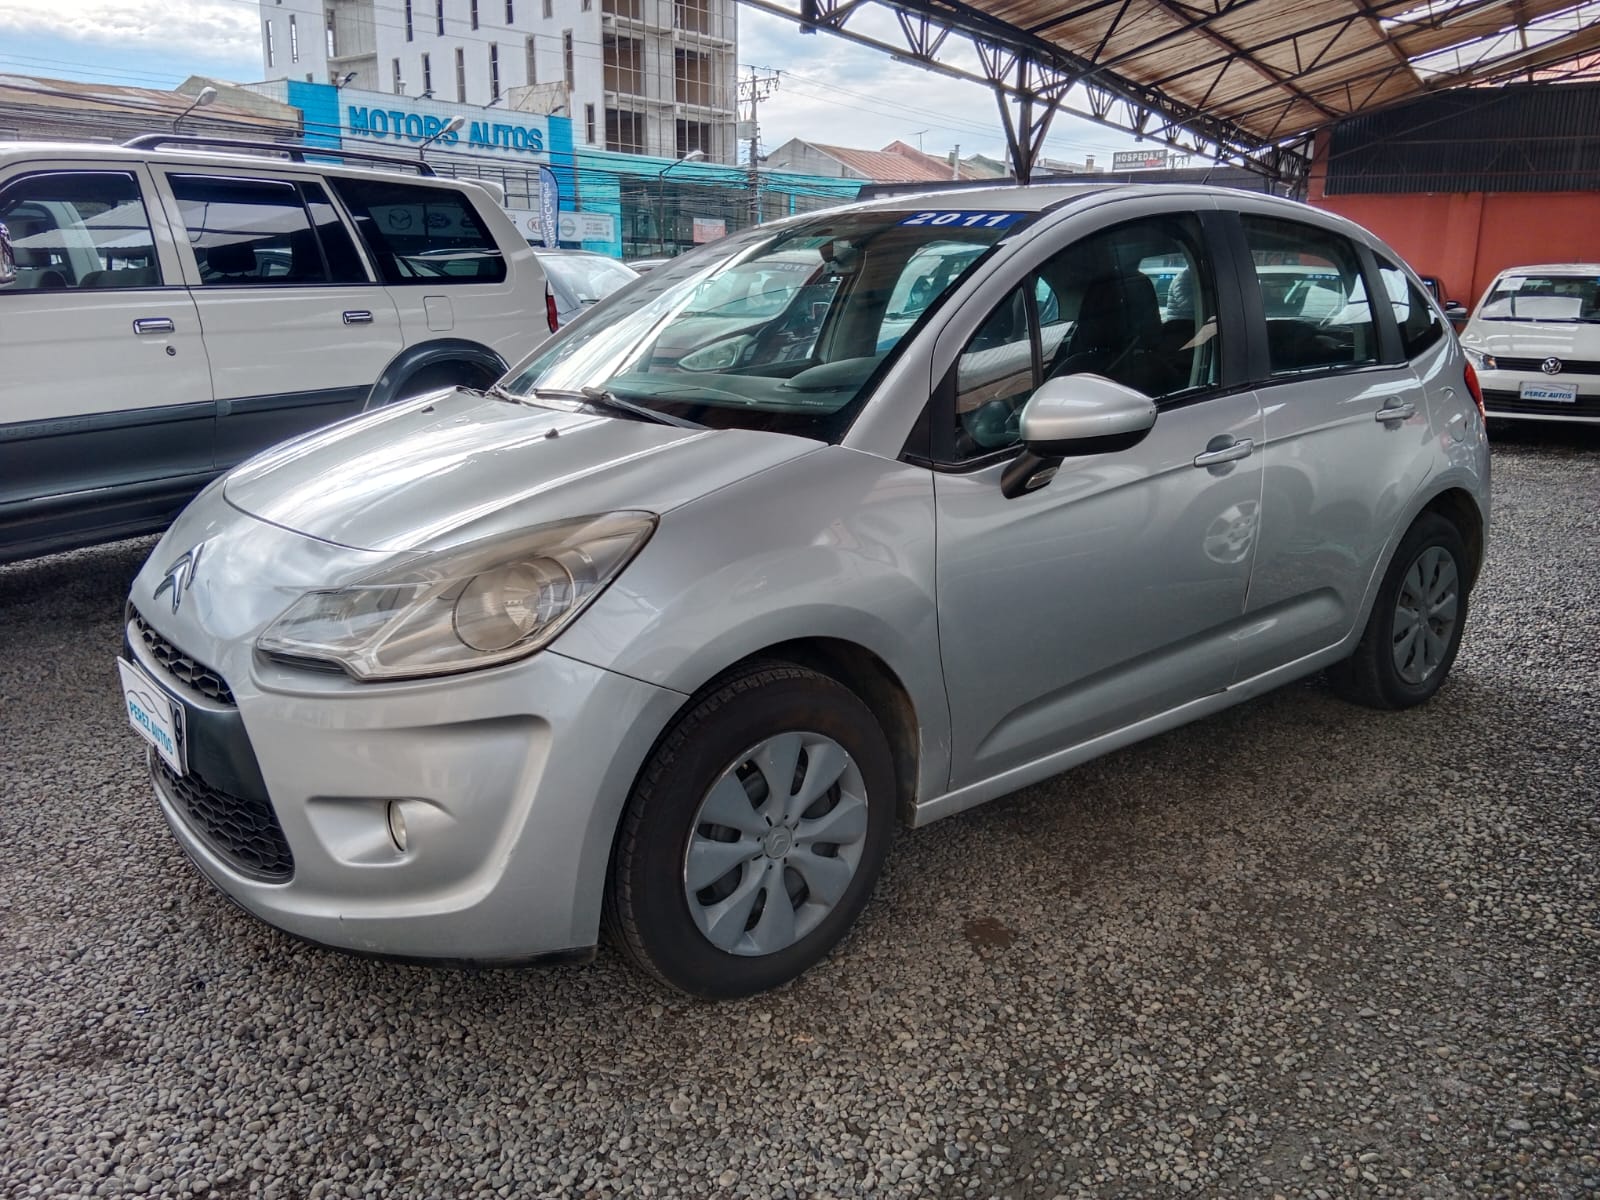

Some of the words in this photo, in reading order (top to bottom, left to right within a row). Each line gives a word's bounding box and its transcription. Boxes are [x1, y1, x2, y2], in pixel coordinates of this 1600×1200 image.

[348, 106, 459, 146] MOTORS
[468, 121, 544, 155] AUTOS
[1115, 151, 1164, 163] HOSPEDAJE
[903, 212, 1011, 227] 2011
[1524, 390, 1547, 398] PEREZ
[1548, 391, 1572, 399] AUTOS
[129, 700, 151, 732] PEREZ
[151, 720, 173, 756] AUTOS
